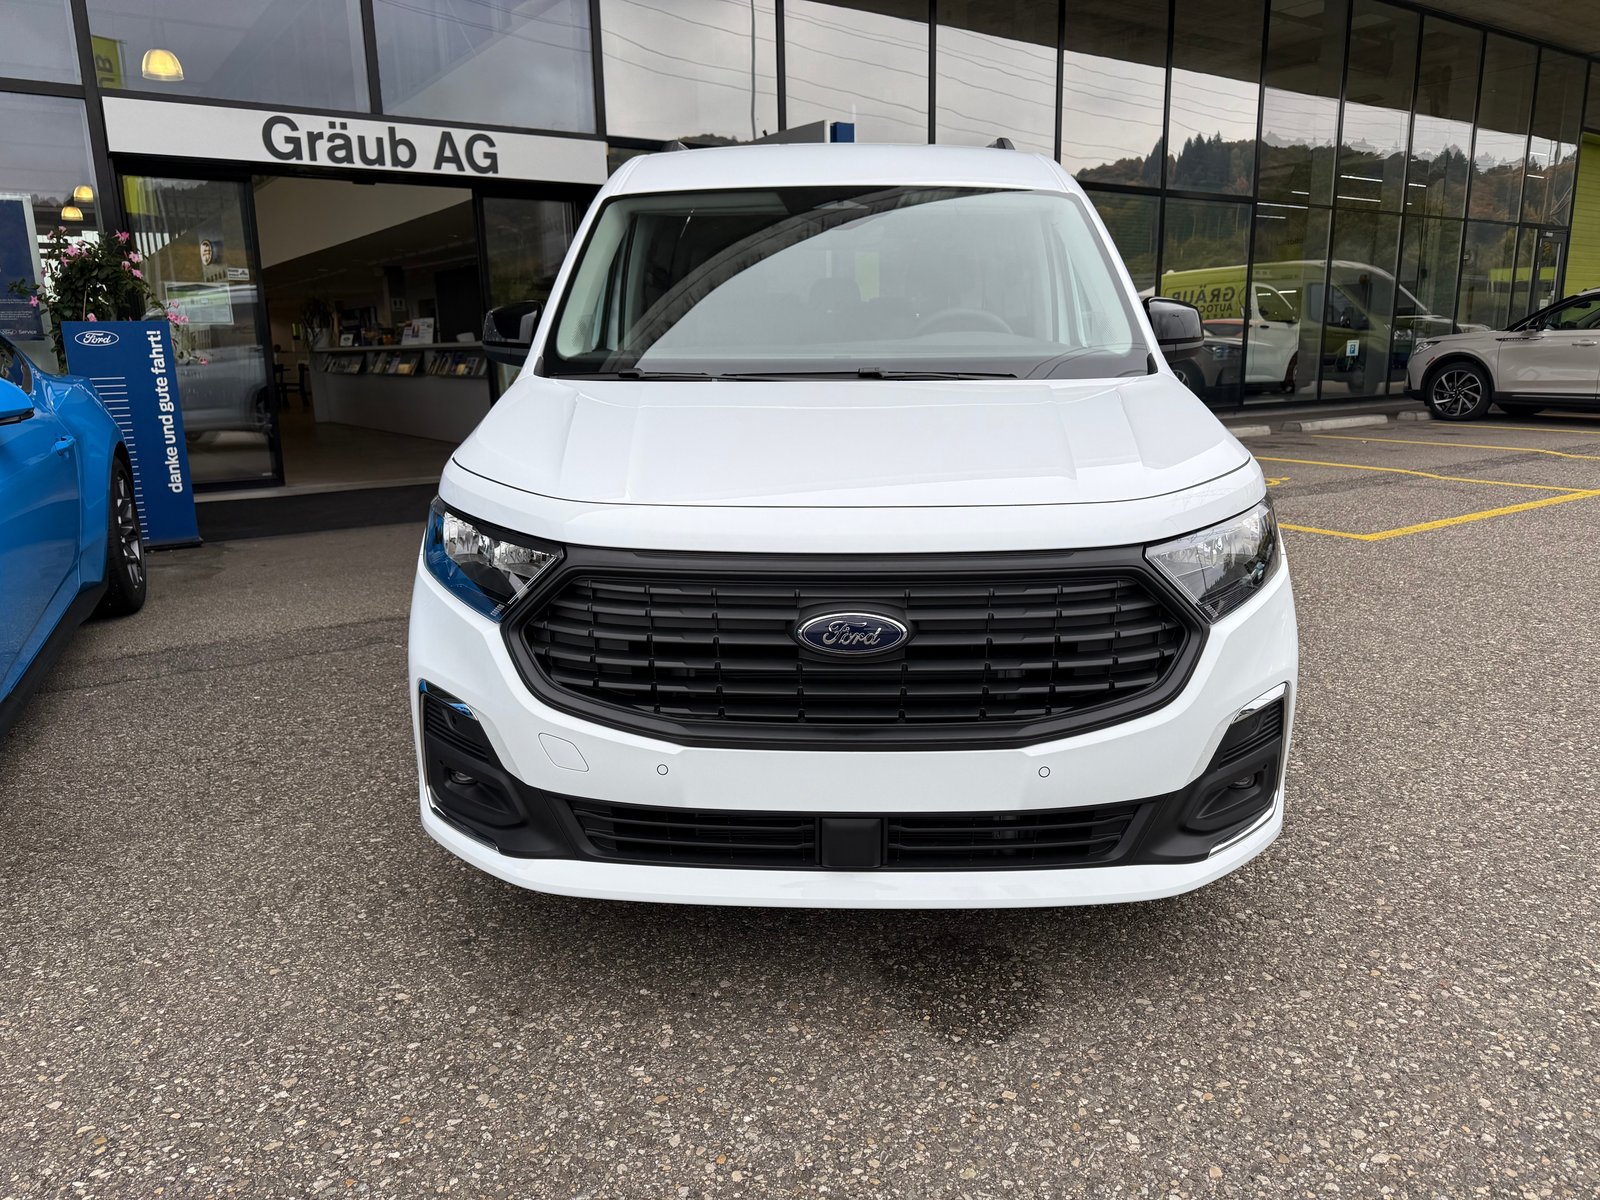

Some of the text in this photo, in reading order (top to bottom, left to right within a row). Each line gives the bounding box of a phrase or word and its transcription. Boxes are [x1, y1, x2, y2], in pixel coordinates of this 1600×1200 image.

[262, 115, 499, 175] Gräub AG
[82, 332, 112, 345] Ford
[146, 330, 184, 494] danke und gute fahrt!
[822, 620, 882, 646] Ford
